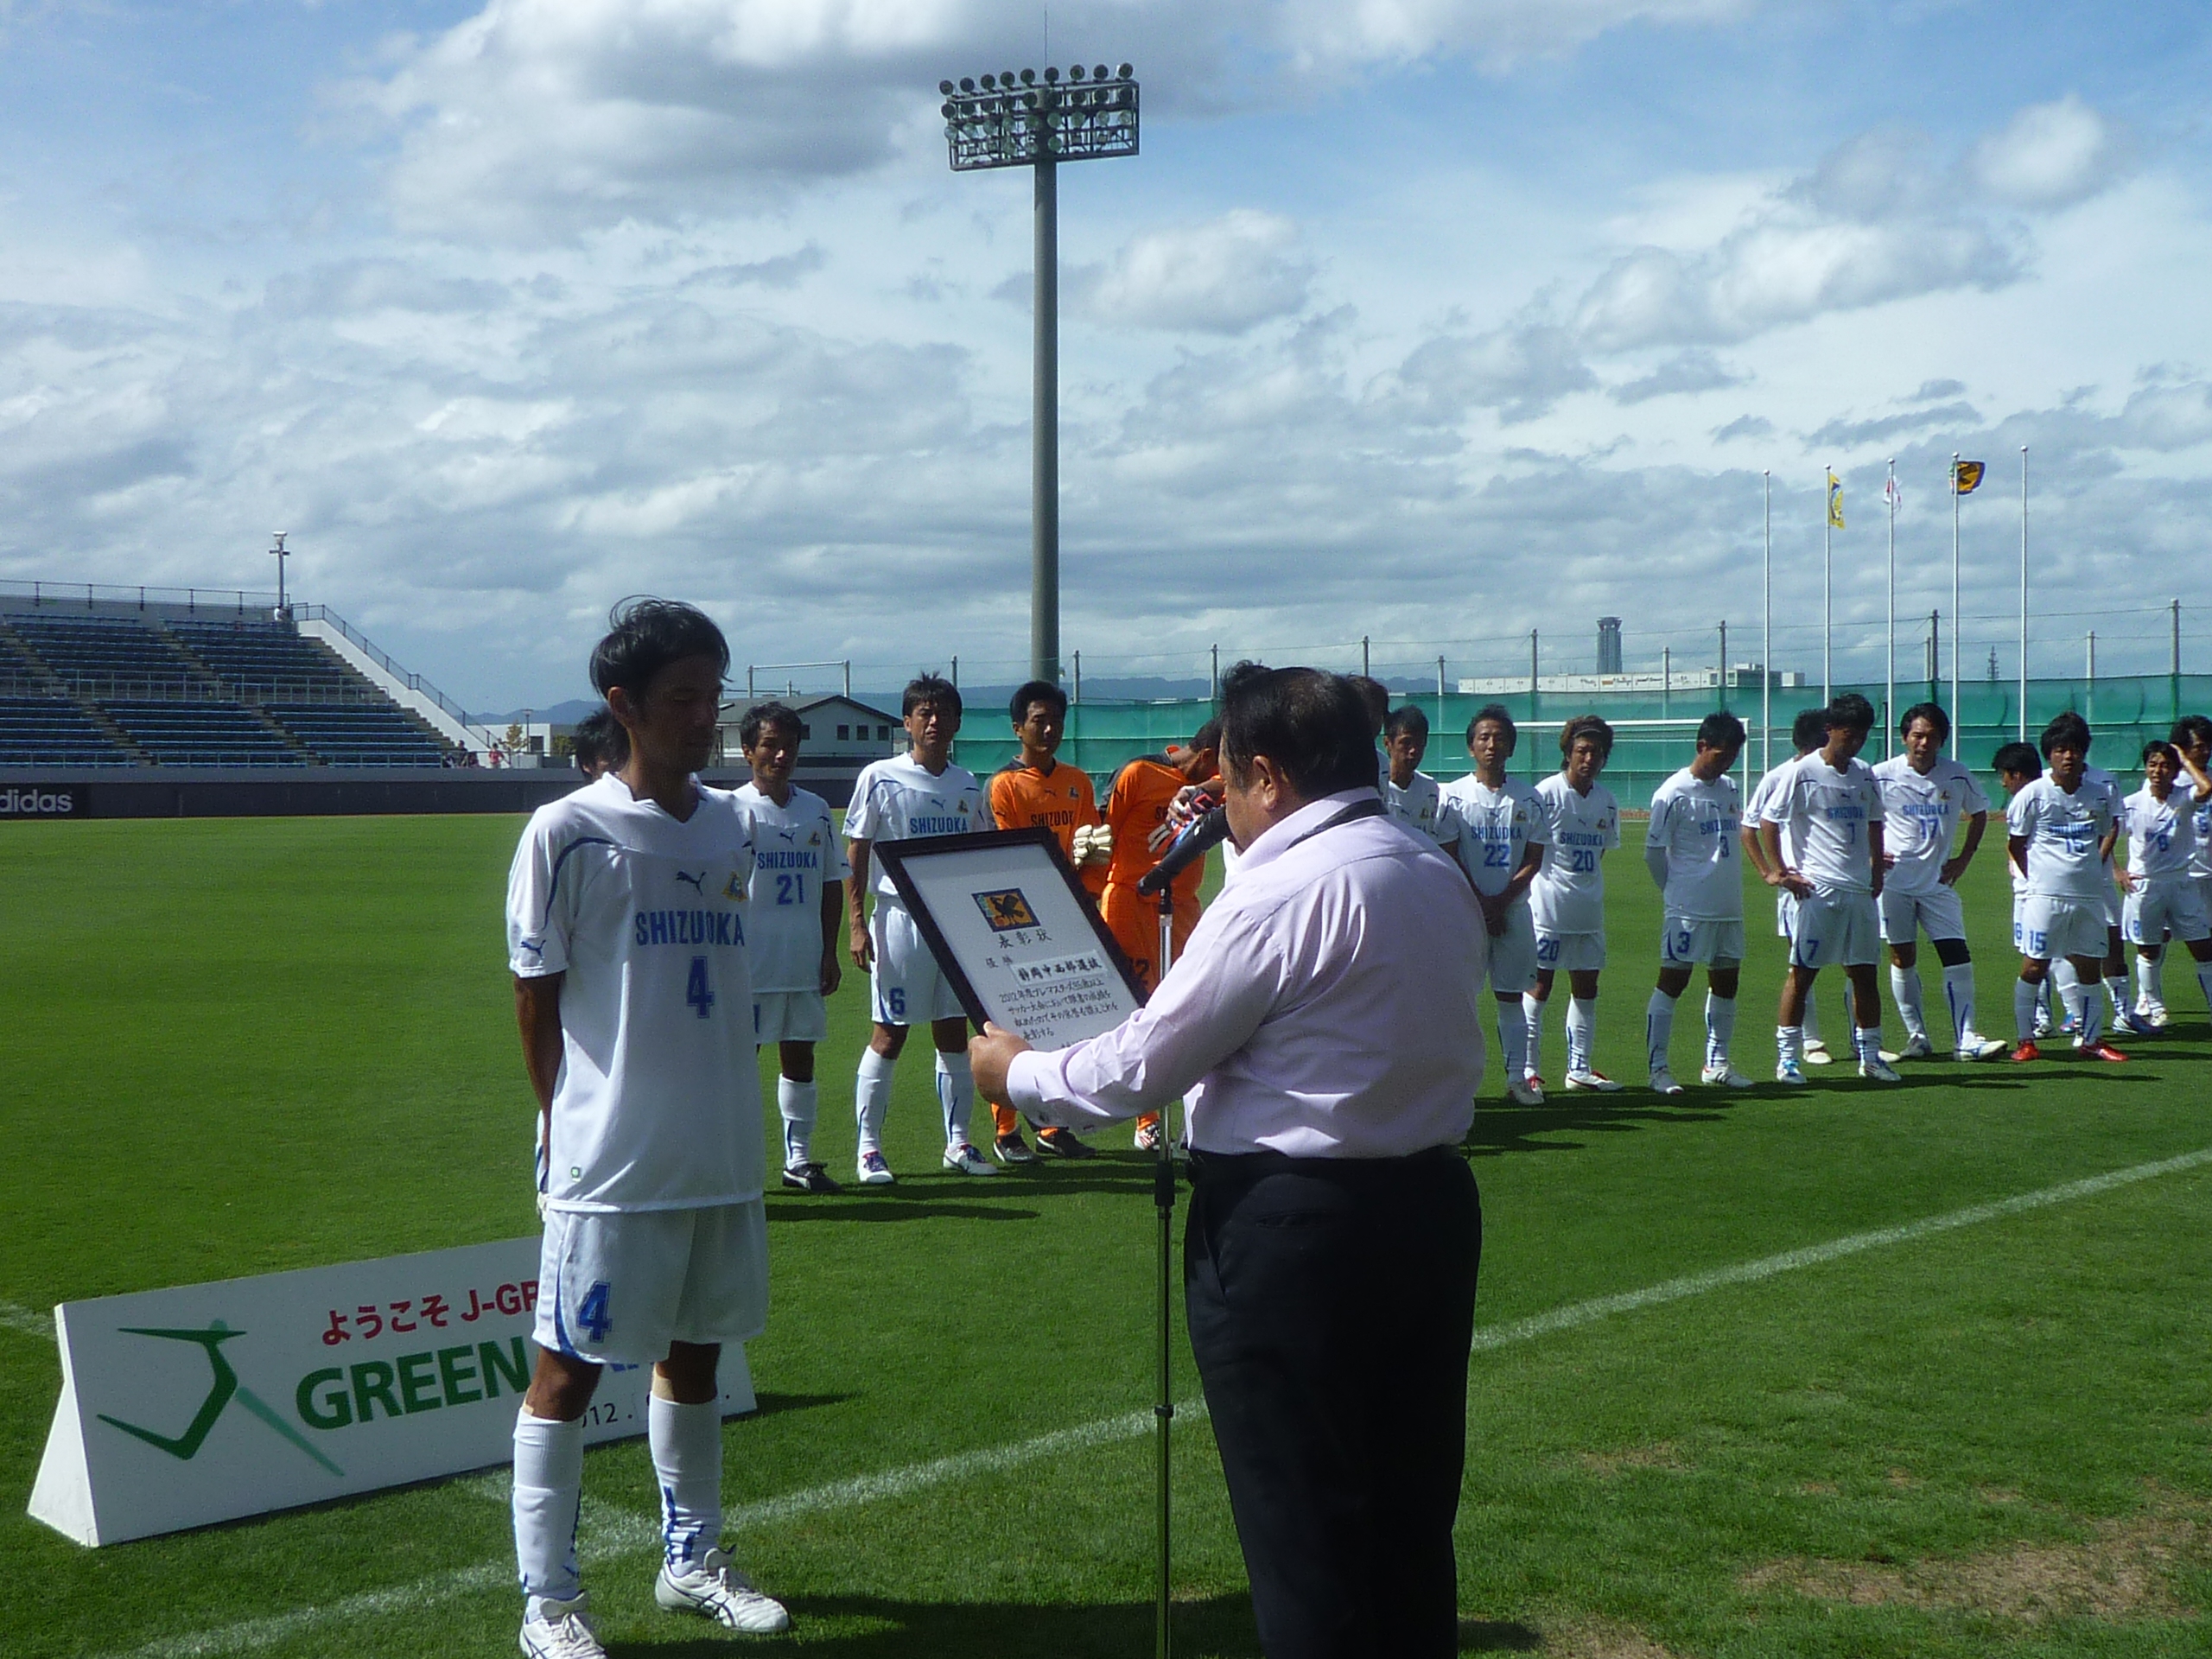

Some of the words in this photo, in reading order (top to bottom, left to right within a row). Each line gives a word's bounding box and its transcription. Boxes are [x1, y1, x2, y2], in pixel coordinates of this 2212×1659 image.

[910, 817, 968, 835] SHIZUOKA
[1471, 826, 1522, 840] SHIZUOKA
[1919, 817, 1939, 840] 17
[757, 851, 818, 870] SHIZUOKA
[1484, 843, 1510, 868] 22
[1573, 849, 1594, 872] 20
[776, 874, 804, 906] 21
[635, 911, 745, 946] SHIZUOKA
[999, 929, 1052, 949] 表彰状
[1537, 938, 1560, 962] 20
[1676, 931, 1691, 954] 3
[1806, 939, 1820, 962] 7
[2030, 930, 2047, 951] 15
[687, 956, 715, 1019] 4
[887, 987, 906, 1017] 6
[321, 1294, 450, 1346] ようこそ
[576, 1281, 613, 1344] 4
[296, 1336, 531, 1431] GREEN
